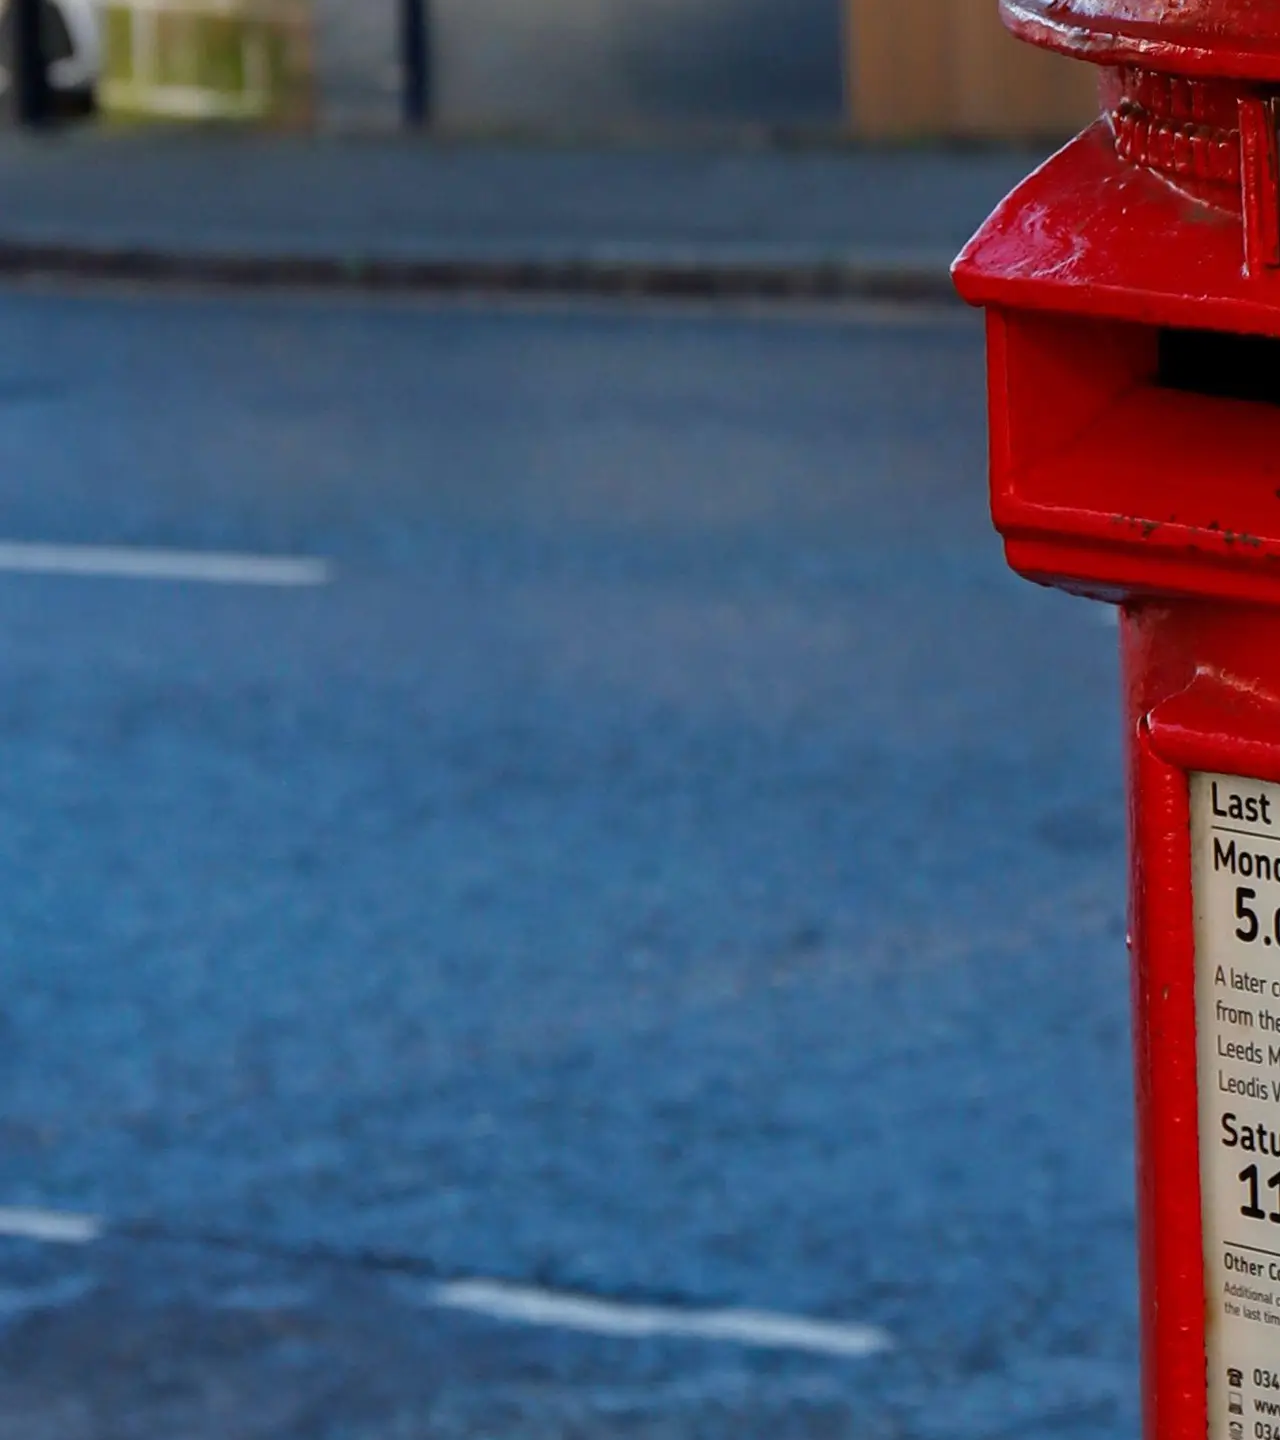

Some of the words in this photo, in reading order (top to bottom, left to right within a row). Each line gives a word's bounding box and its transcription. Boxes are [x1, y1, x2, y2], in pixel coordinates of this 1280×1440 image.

[1211, 780, 1272, 825] Last
[1214, 964, 1227, 987] A
[1230, 967, 1268, 995] later
[1215, 999, 1254, 1027] from
[1217, 1034, 1264, 1065] Leeds
[1218, 1069, 1269, 1101] Leodis
[1223, 1251, 1265, 1277] Other
[1223, 1281, 1274, 1305] Additional
[1223, 1301, 1241, 1317] the
[1242, 1305, 1262, 1322] last
